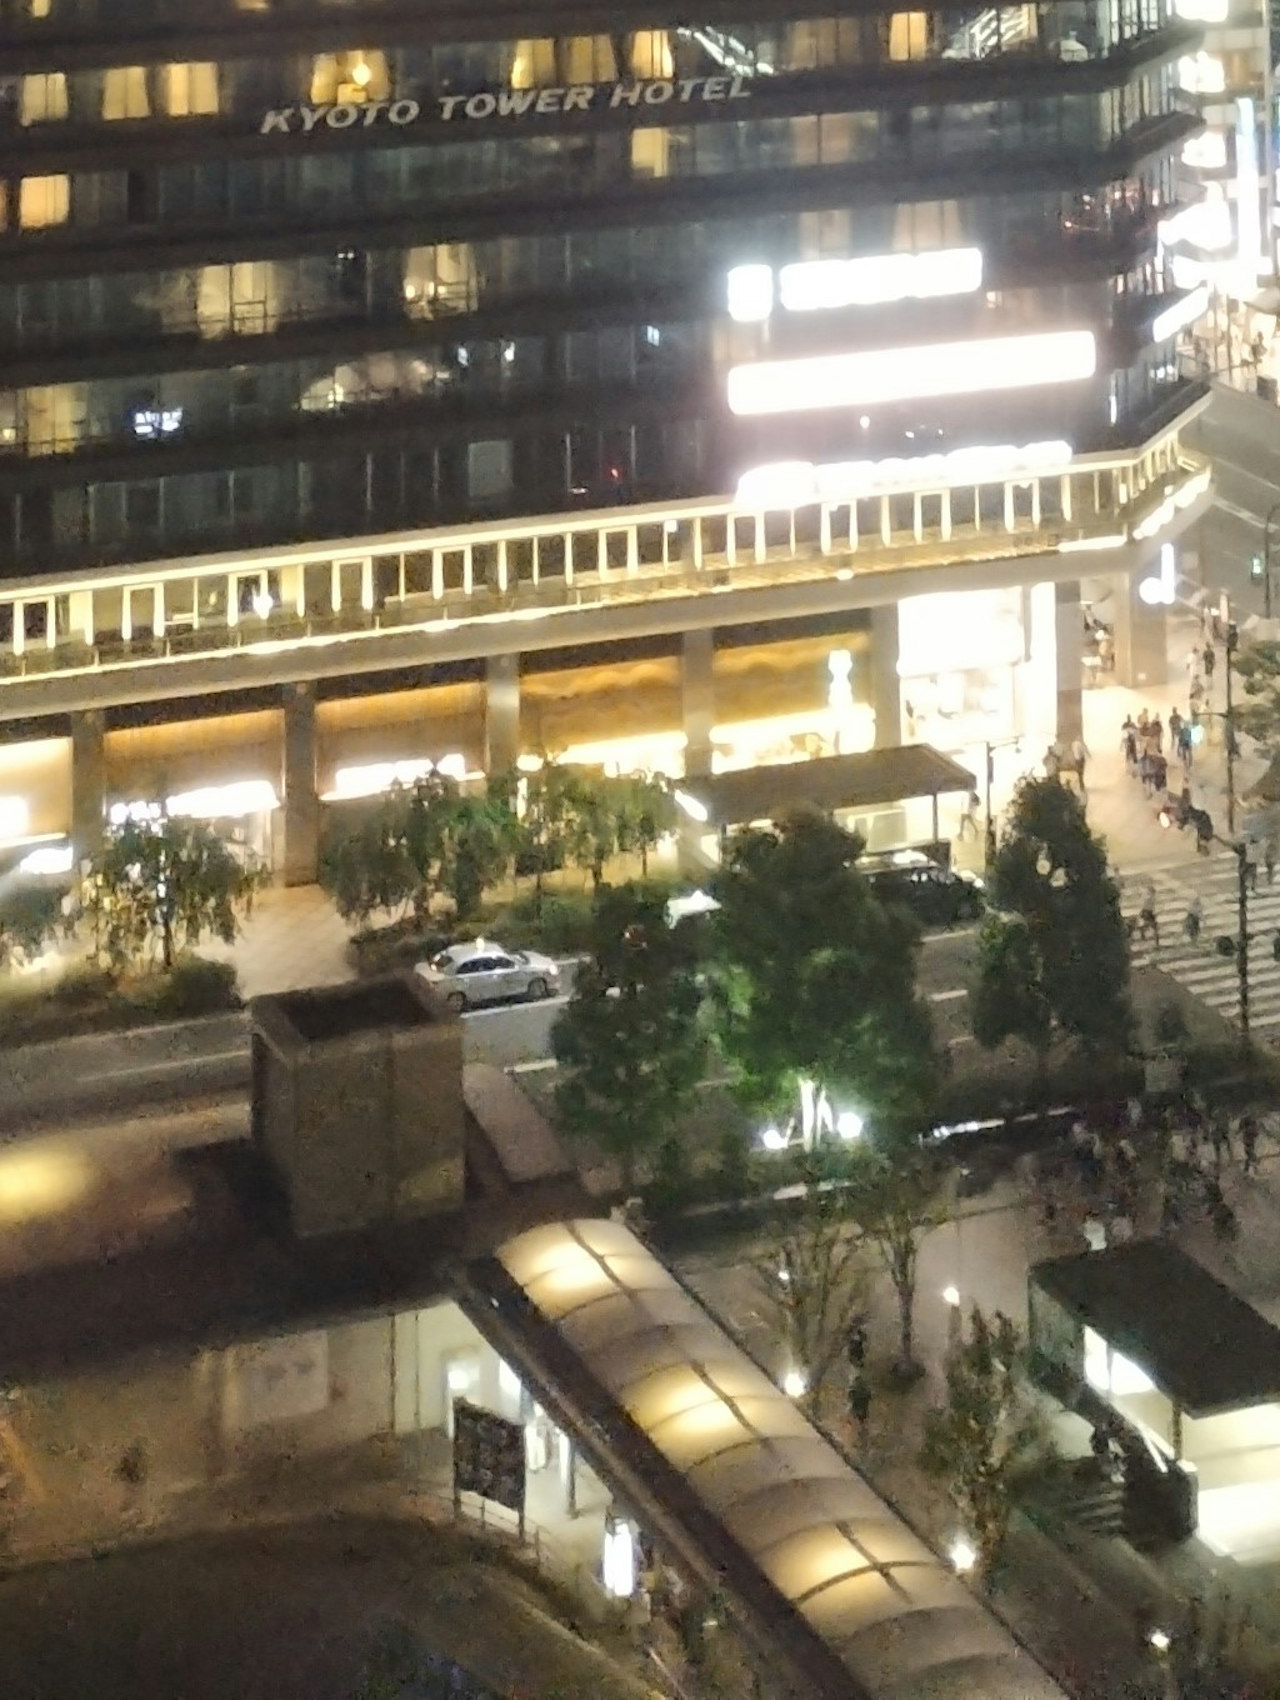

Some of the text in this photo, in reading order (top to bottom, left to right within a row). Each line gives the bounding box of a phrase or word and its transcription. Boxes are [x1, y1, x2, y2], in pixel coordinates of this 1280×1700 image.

[260, 75, 753, 133] KYOTO TOWER HOTEL
